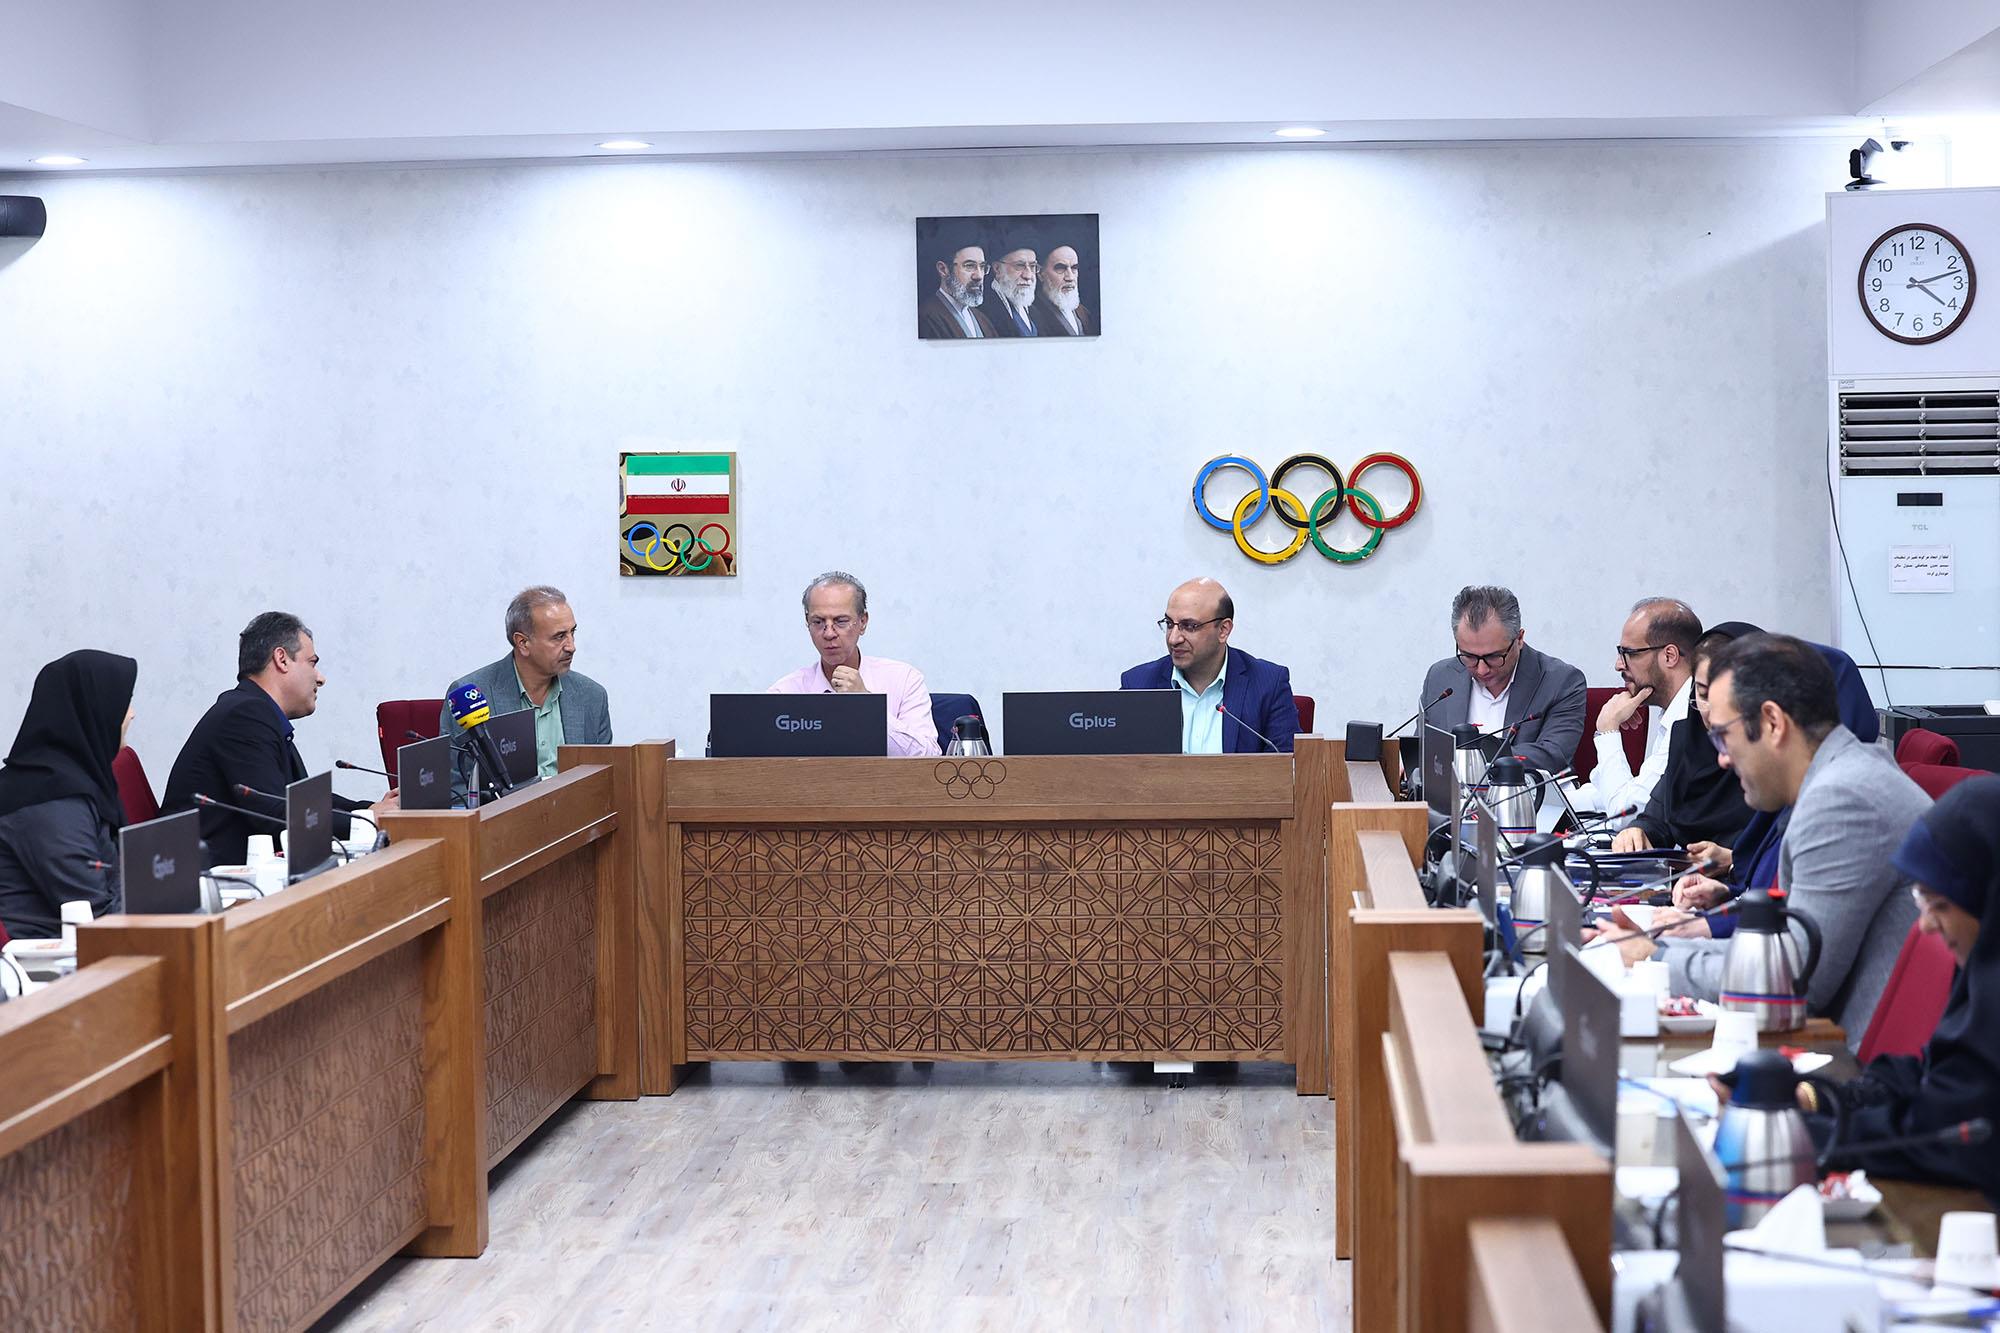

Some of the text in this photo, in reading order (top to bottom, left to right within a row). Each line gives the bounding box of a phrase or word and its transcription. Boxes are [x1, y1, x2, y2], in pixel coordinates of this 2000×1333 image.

[1891, 242, 1904, 256] 11
[1909, 236, 1925, 250] 12
[1934, 241, 1940, 255] 1
[1877, 258, 1893, 272] 10
[1947, 255, 1957, 269] 2
[1872, 278, 1882, 292] 9
[1953, 276, 1964, 290] 3
[1879, 298, 1890, 312] 8
[1947, 297, 1957, 310] 4
[1894, 312, 1904, 326] 7
[1912, 317, 1923, 331] 6
[1932, 312, 1943, 326] 5
[775, 714, 822, 732] Gplus
[1069, 712, 1117, 730] Gplus
[500, 738, 517, 757] Gplus
